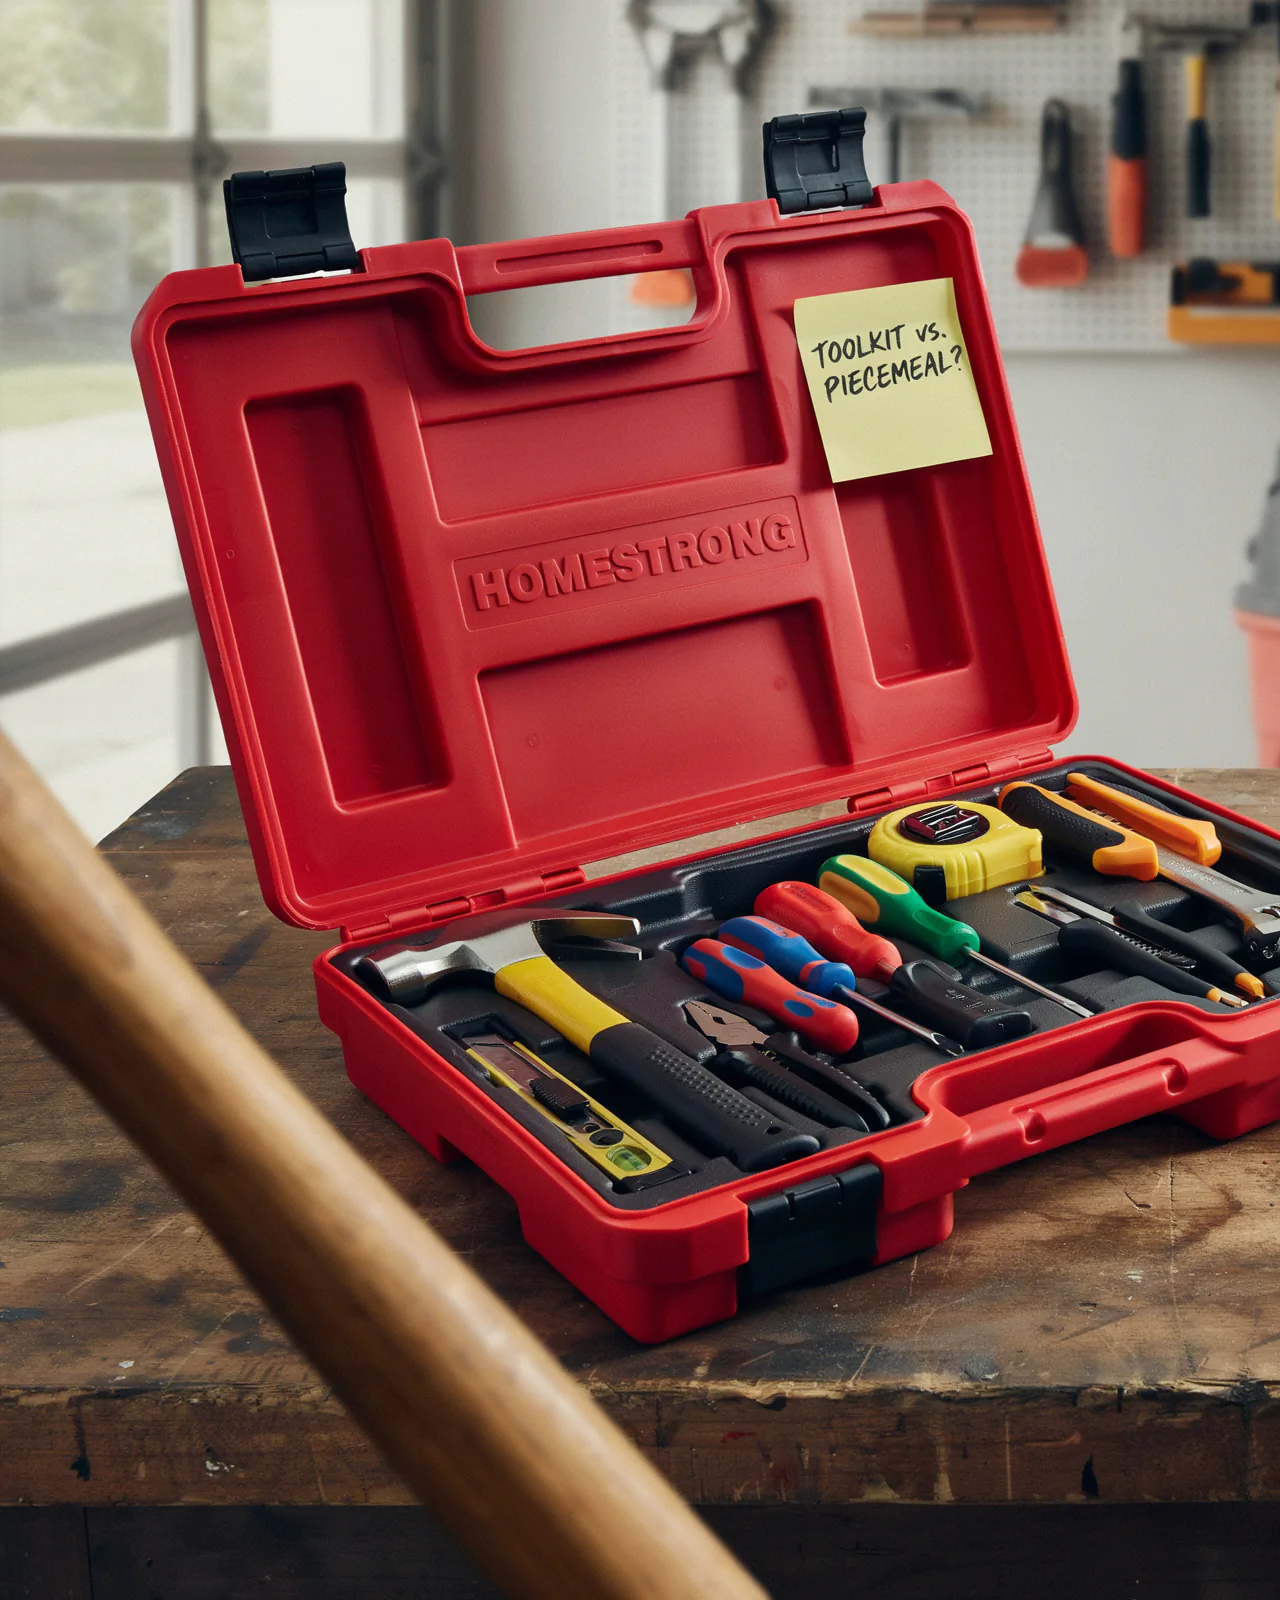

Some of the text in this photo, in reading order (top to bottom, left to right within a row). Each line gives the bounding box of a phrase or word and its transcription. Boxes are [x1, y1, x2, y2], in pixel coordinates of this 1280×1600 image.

[811, 323, 906, 369] TOOLKIT
[823, 344, 963, 404] PIECEMEAL?
[470, 513, 797, 611] HOMESTRONG
